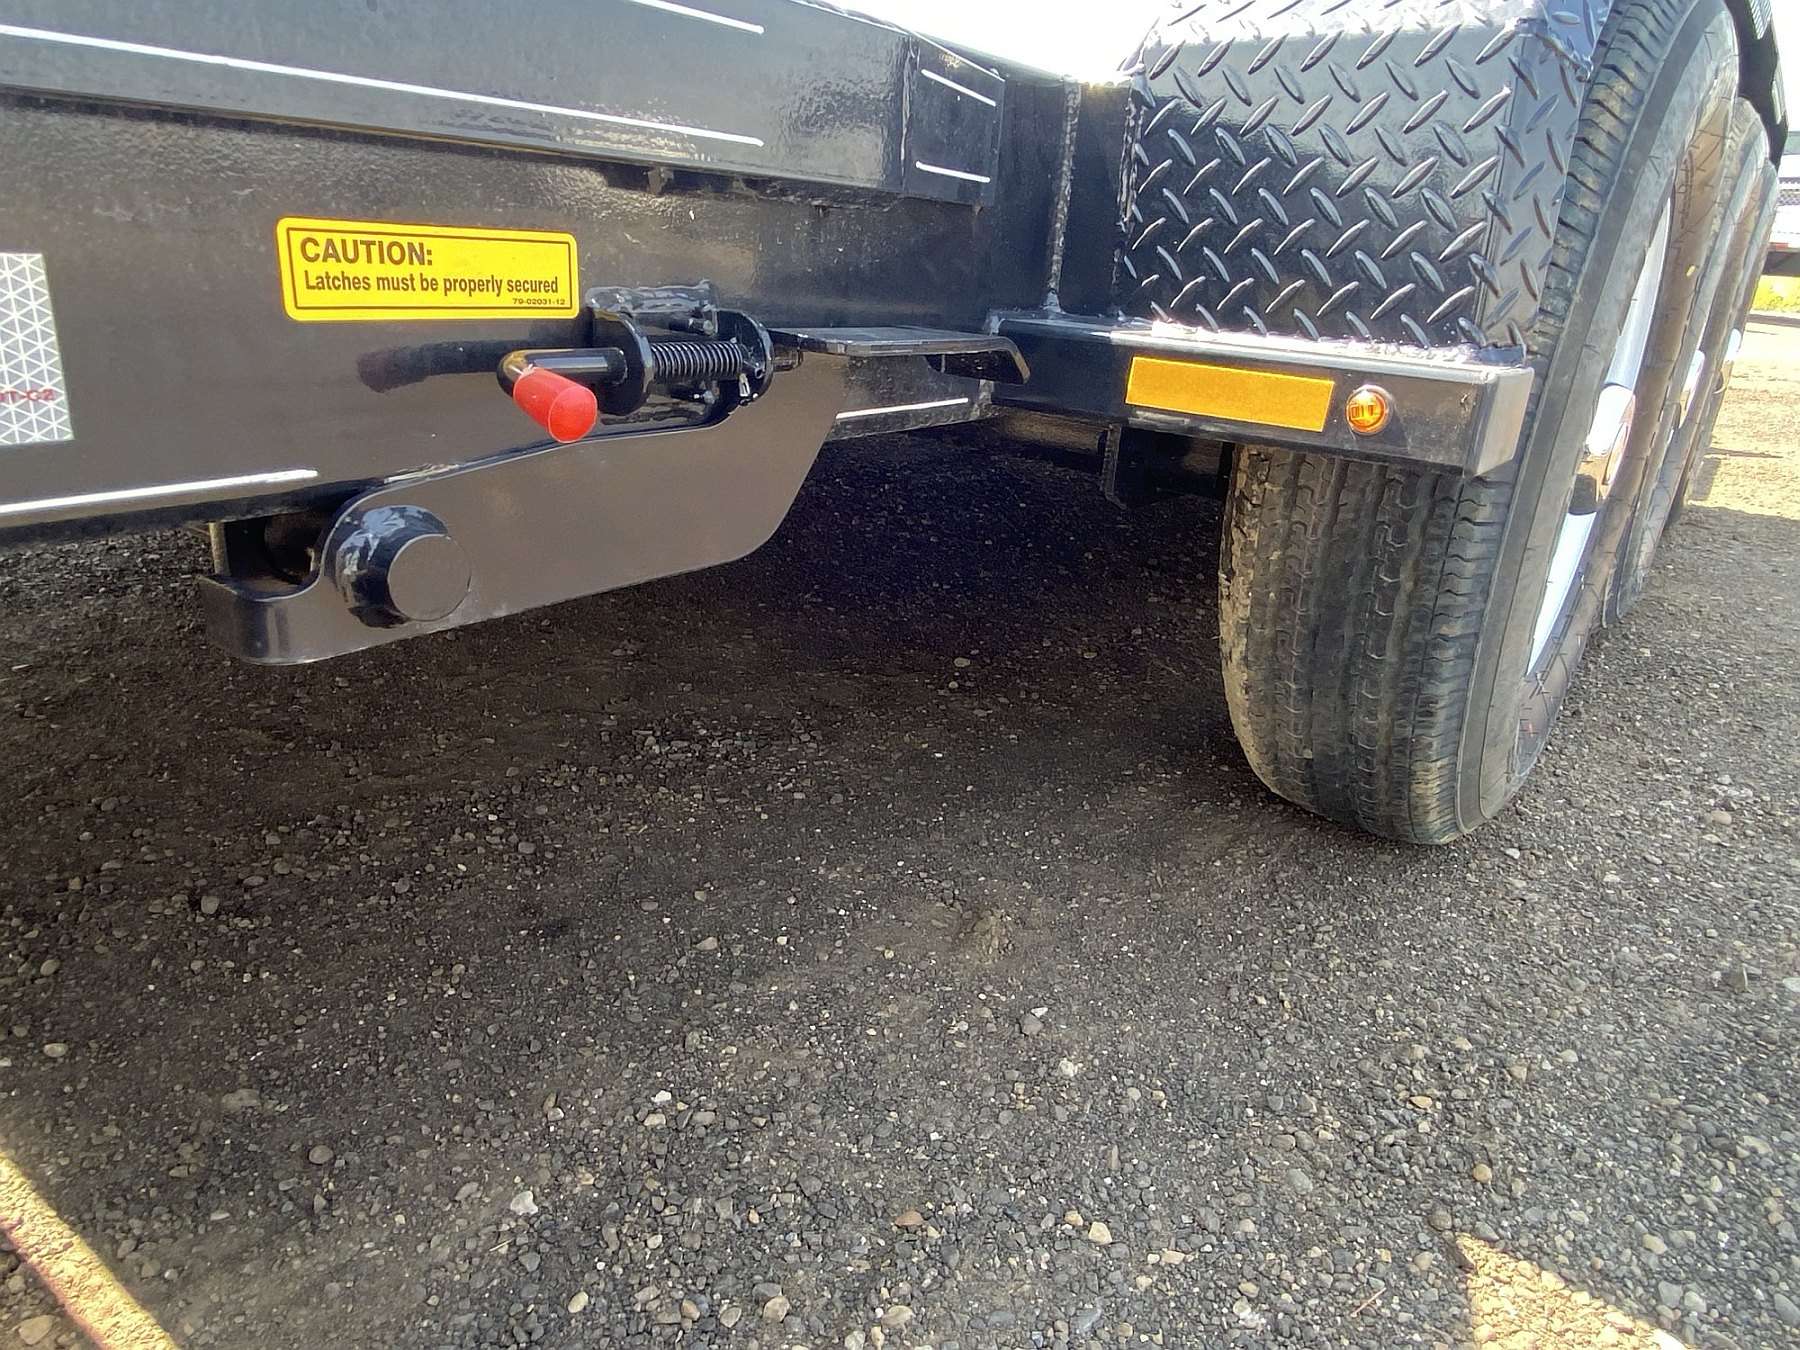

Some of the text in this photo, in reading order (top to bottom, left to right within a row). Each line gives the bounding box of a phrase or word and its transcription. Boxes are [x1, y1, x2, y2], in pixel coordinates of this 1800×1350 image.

[300, 237, 433, 266] CAUTION:
[304, 270, 559, 297] Latches must be properly secured
[512, 297, 566, 306] 79-02031-12
